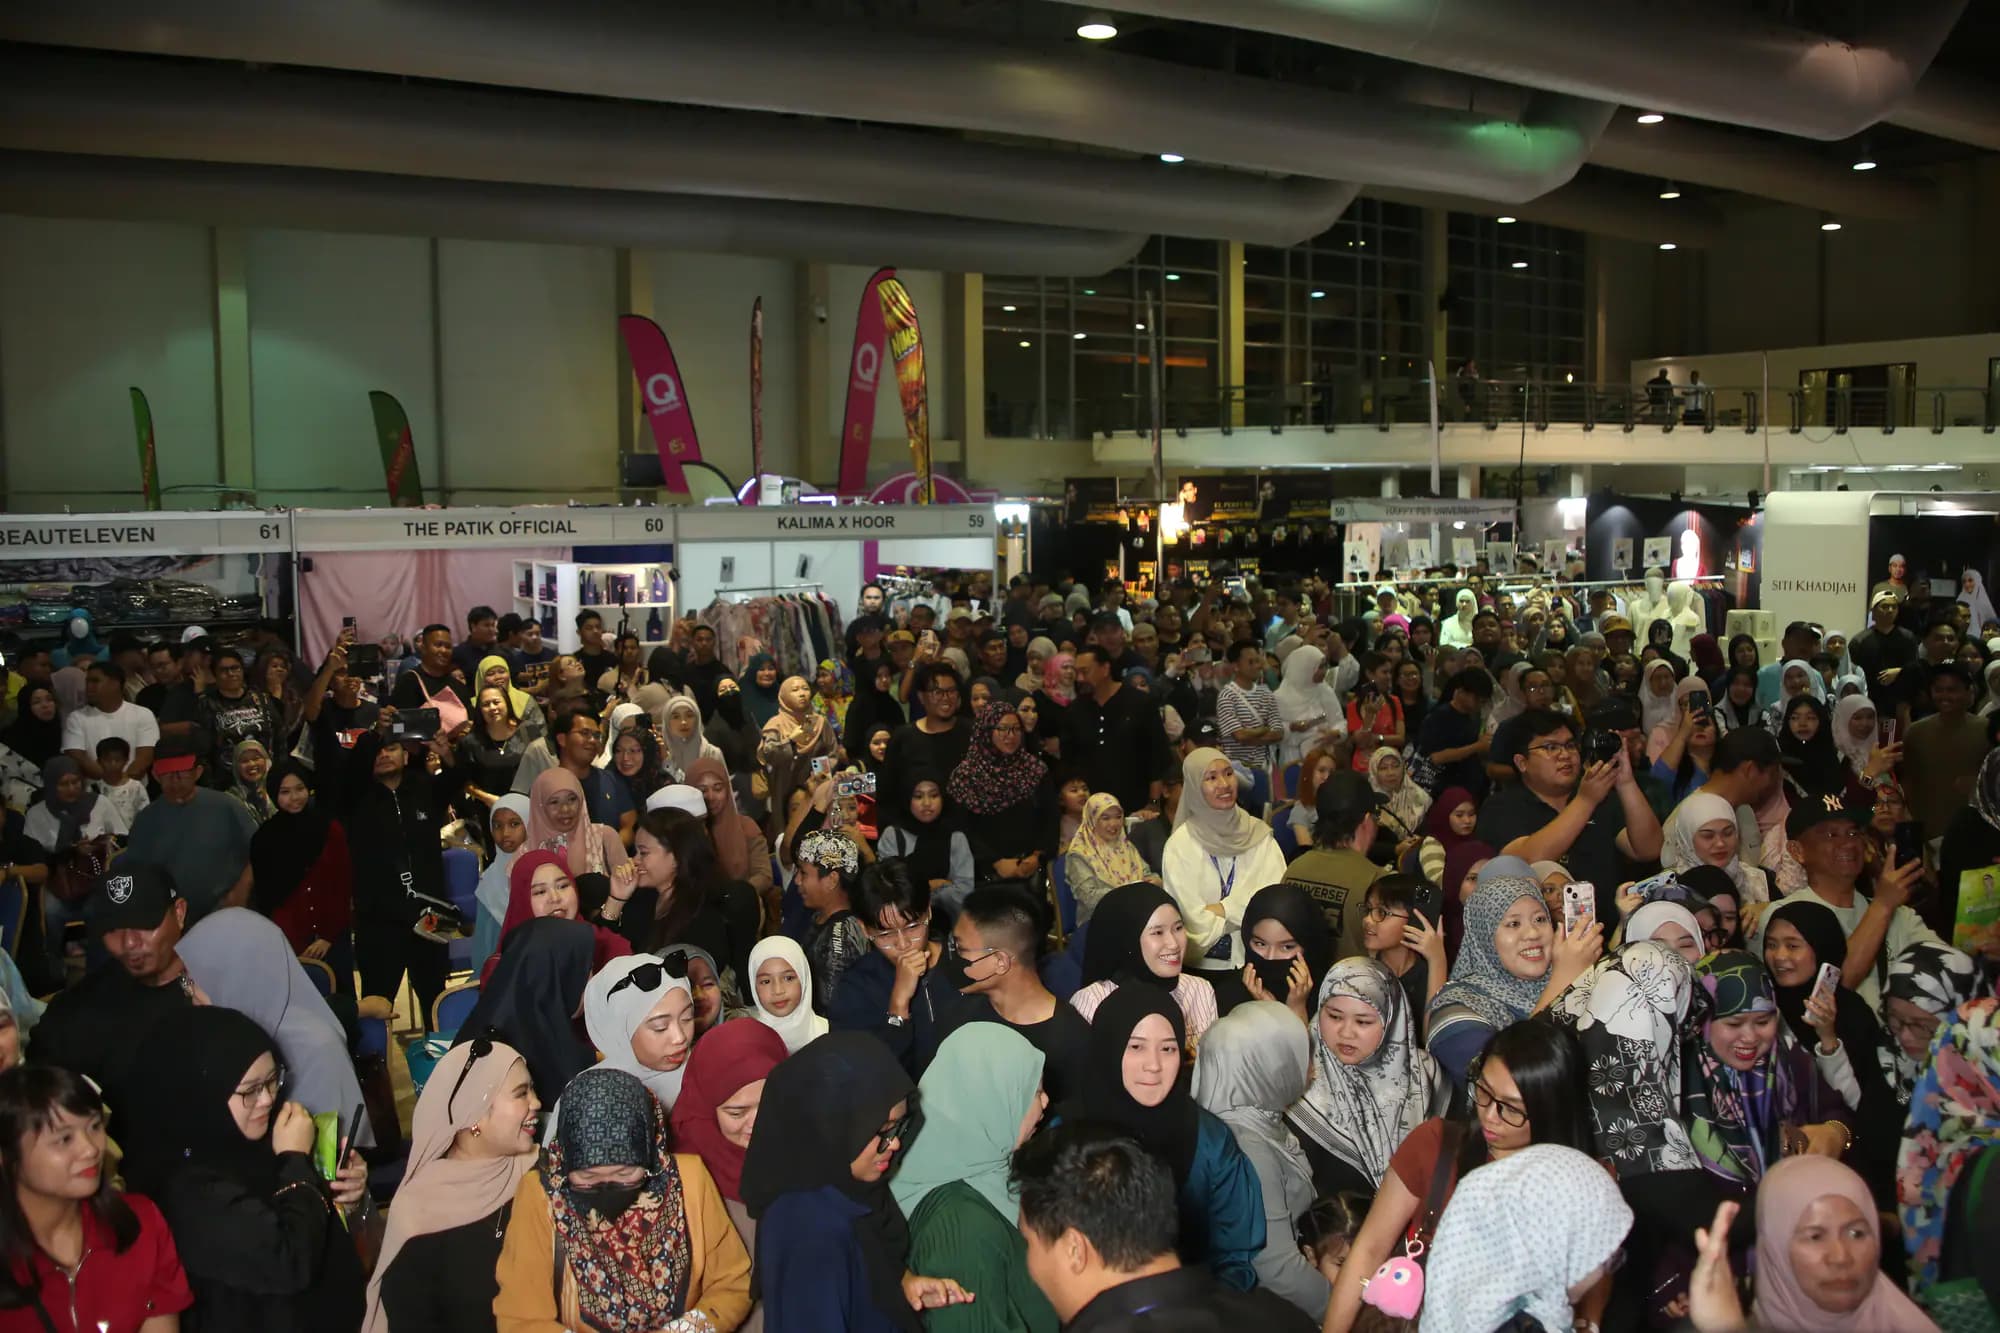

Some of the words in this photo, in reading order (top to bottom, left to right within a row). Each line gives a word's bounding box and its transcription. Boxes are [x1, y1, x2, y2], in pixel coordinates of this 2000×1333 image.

[646, 373, 679, 406] Q
[404, 522, 439, 536] THE
[445, 521, 494, 535] PATIK
[499, 520, 577, 534] OFFICIAL
[645, 518, 664, 532] 60
[777, 516, 835, 529] KALIMA
[839, 516, 848, 529] X
[852, 515, 895, 528] HOOR
[968, 515, 984, 528] 59
[259, 524, 281, 539] 61
[1771, 580, 1792, 591] SITI
[1796, 580, 1856, 595] KHADIJAH
[1822, 794, 1844, 812] NY
[1287, 881, 1345, 902] NVERSE
